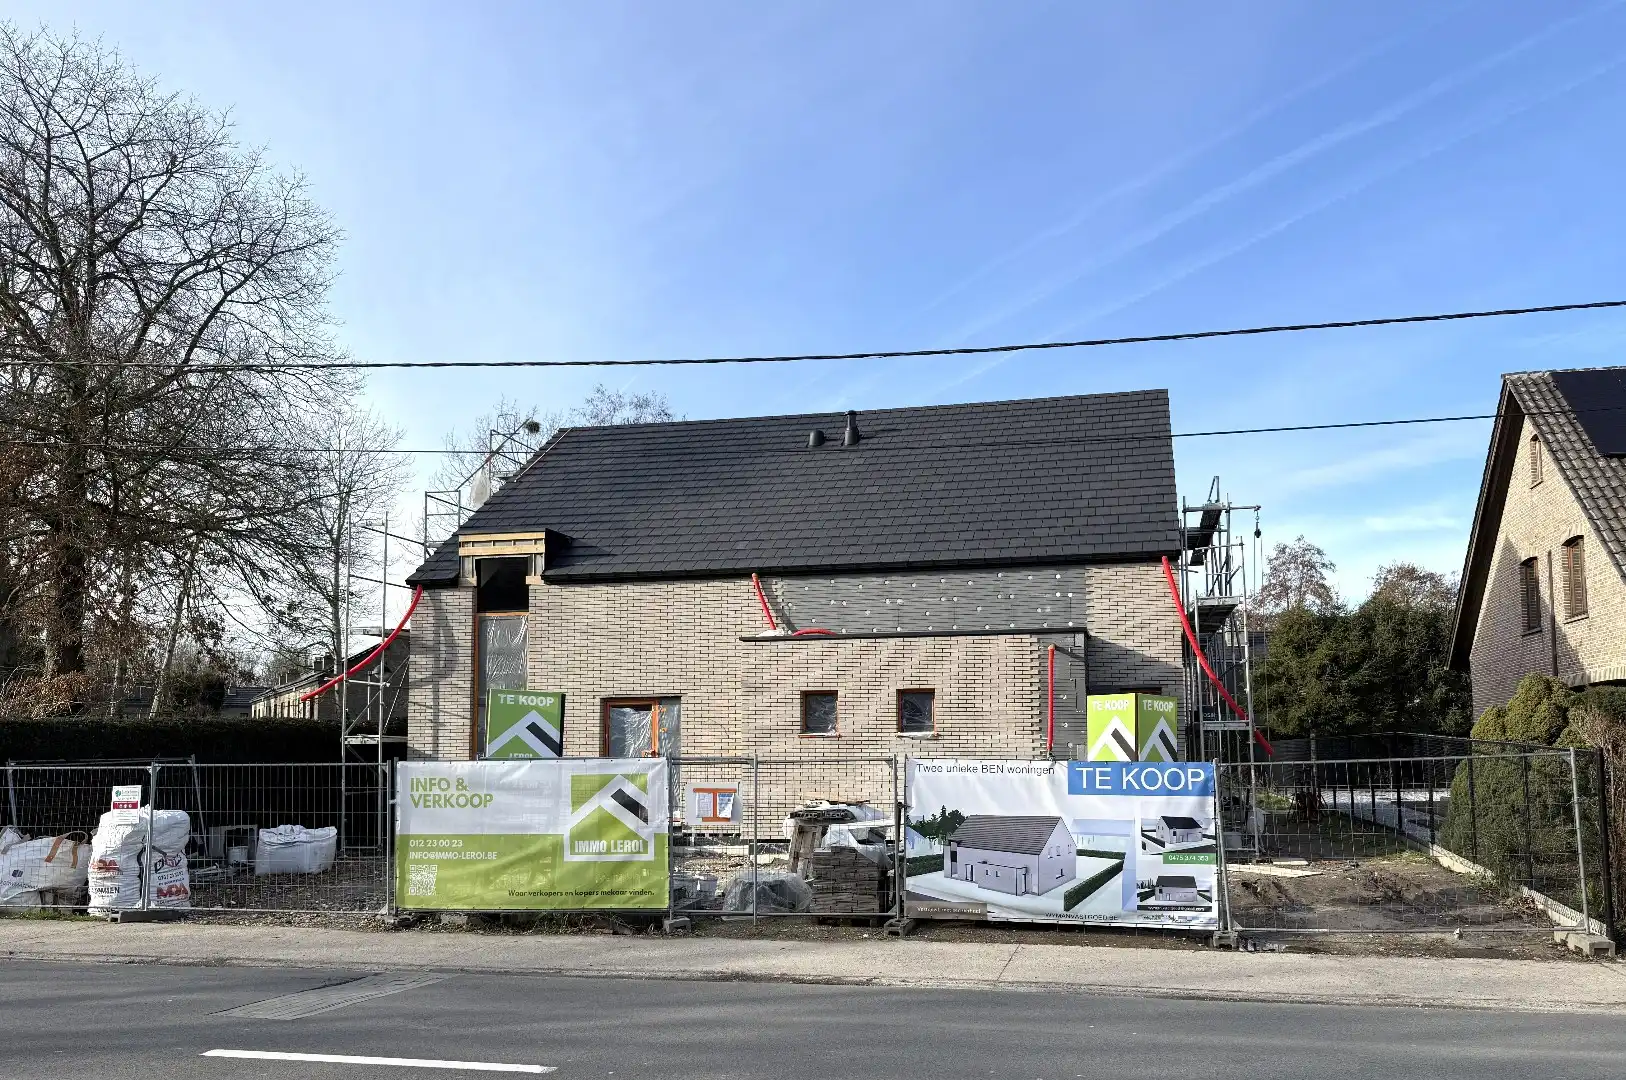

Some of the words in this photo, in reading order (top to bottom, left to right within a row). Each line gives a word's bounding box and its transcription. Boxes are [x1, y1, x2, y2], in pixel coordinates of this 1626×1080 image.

[498, 693, 515, 705] TE
[519, 695, 554, 707] KOOP
[1092, 700, 1103, 711] TE
[1104, 699, 1129, 711] KOOP
[1142, 700, 1152, 711] TE
[1154, 700, 1174, 712] KOOP
[916, 763, 943, 773] Twee
[946, 763, 978, 773] unieke
[981, 764, 1004, 774] BEN
[1007, 764, 1055, 776] woningen
[410, 777, 451, 792] INFO
[455, 777, 469, 792] &
[1075, 767, 1112, 790] TE
[1122, 767, 1205, 791] KOOP
[409, 793, 494, 809] VERKOOP
[409, 839, 424, 847] 012
[426, 839, 437, 847] 23
[438, 839, 450, 847] 00
[451, 839, 463, 847] 23
[574, 840, 607, 853] IMMO
[611, 840, 643, 853] LEROI
[409, 851, 498, 860] INFO@IMMO-LEROI.BE
[508, 889, 528, 897] Waar
[528, 889, 563, 898] verkopers
[574, 889, 598, 898] kopers
[628, 888, 655, 896] vinden.
